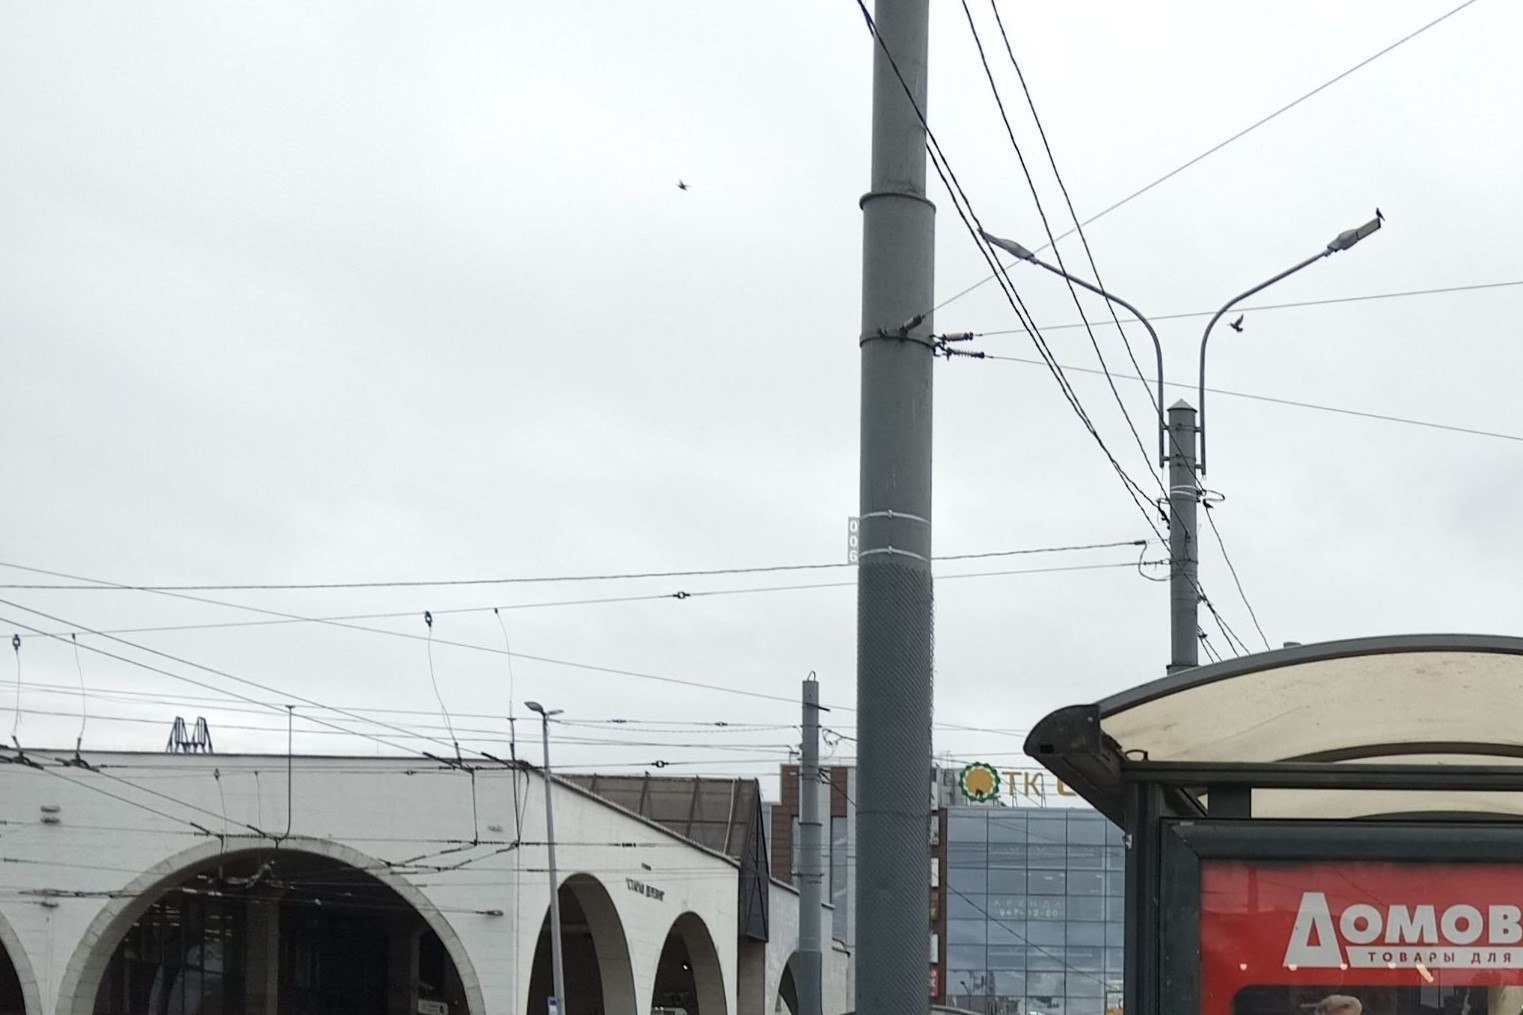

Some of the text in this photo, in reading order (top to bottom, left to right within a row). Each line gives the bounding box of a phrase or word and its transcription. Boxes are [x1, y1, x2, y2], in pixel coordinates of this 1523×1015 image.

[849, 520, 858, 562] 006
[1001, 771, 1043, 796] ТК
[1368, 952, 1455, 963] ТОВАРЫ
[1471, 952, 1512, 965] ДЛЯ
